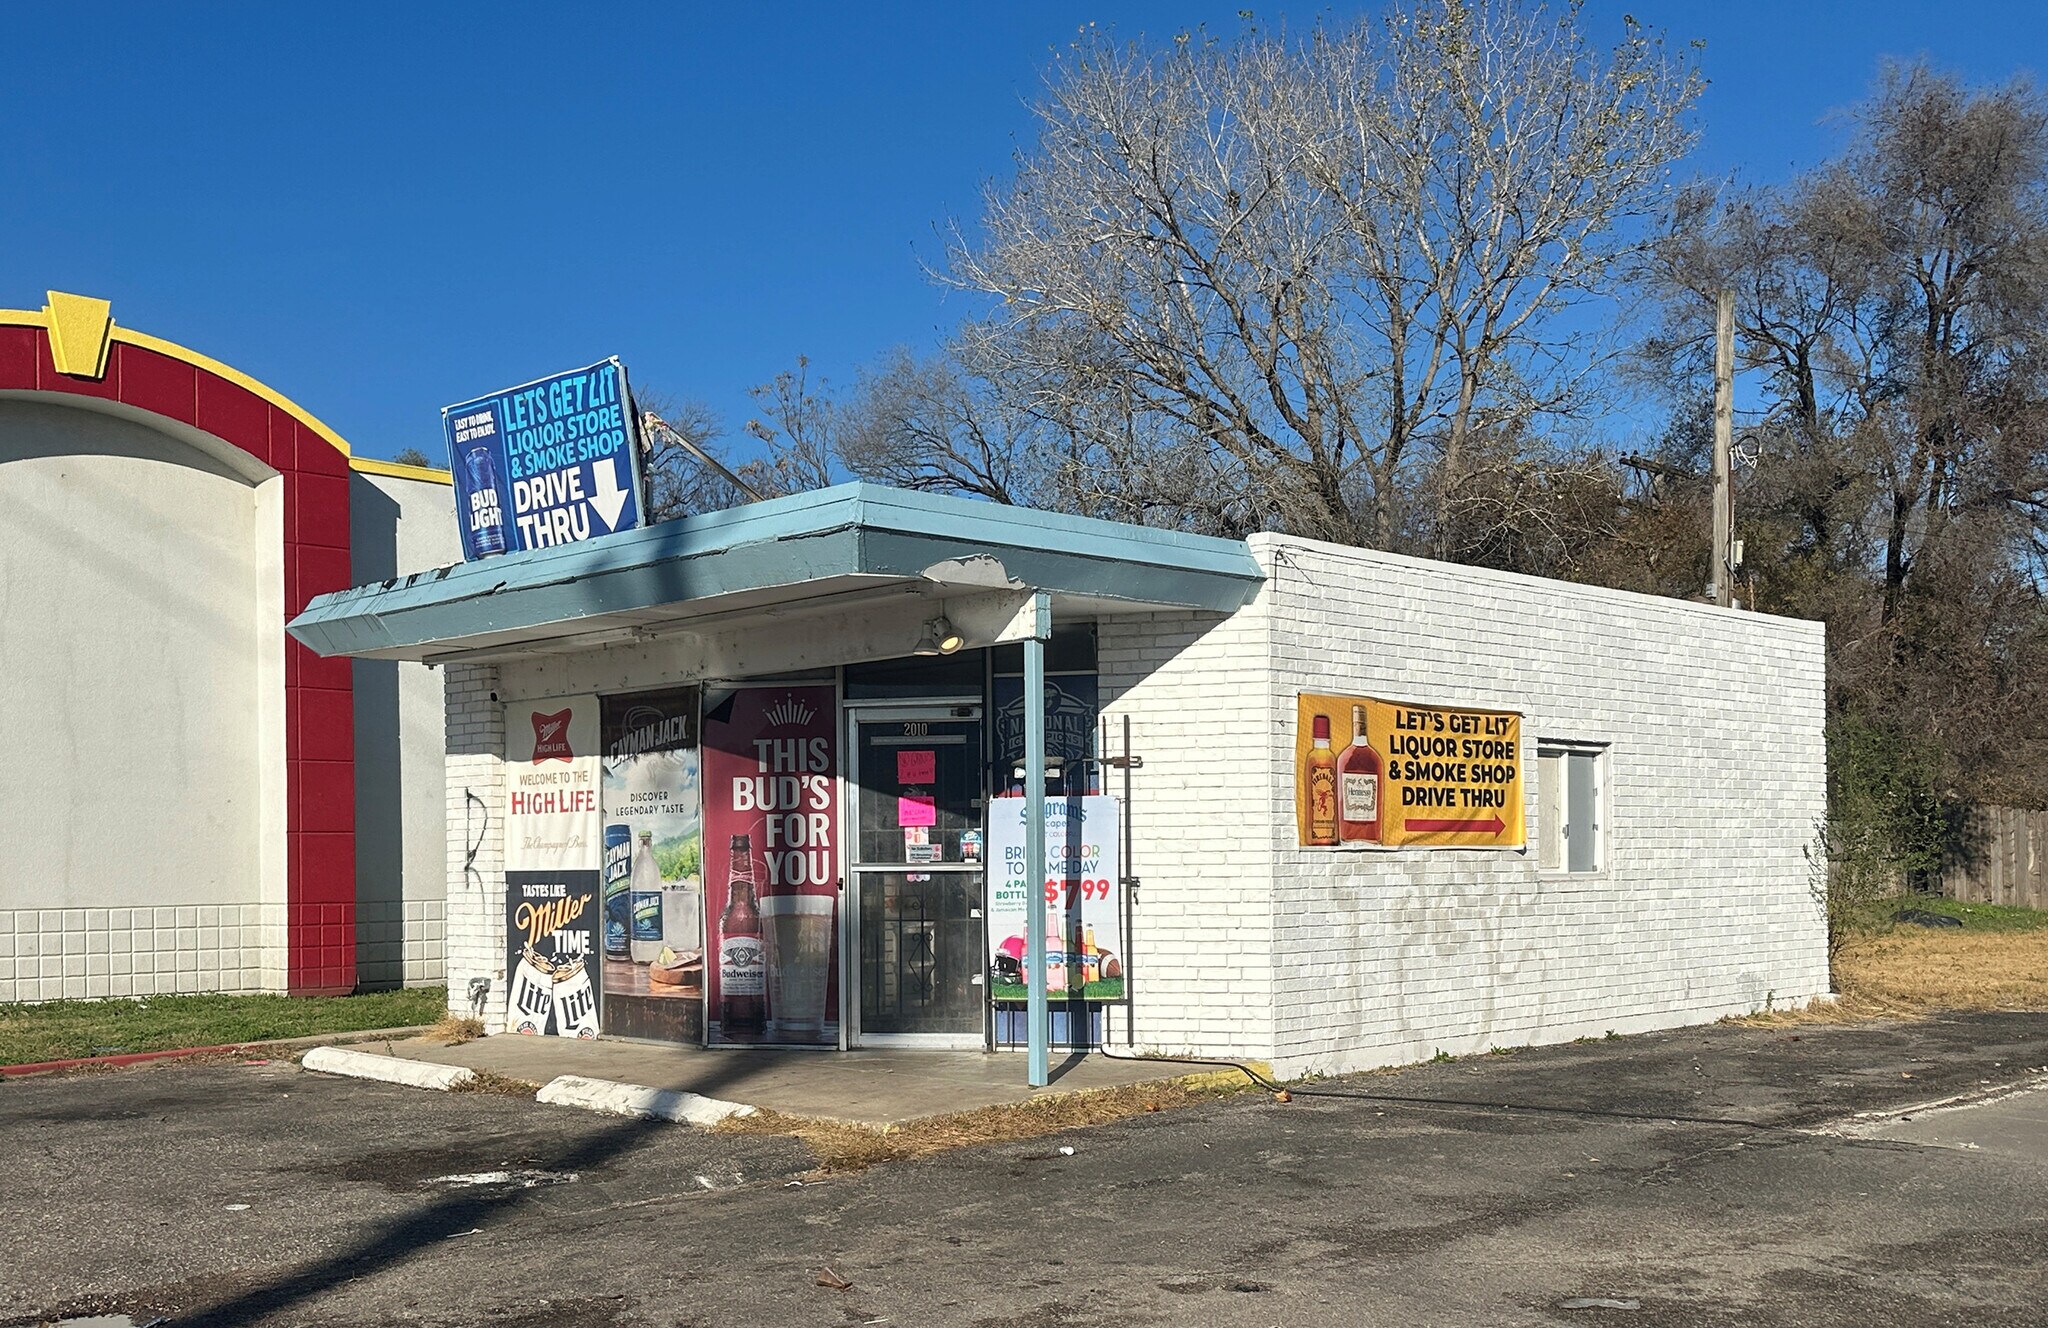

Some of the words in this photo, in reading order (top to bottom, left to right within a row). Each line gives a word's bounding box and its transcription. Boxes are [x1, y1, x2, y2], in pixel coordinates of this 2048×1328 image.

[503, 387, 548, 432] LETS
[549, 376, 587, 419] GET
[588, 365, 616, 408] LIT
[456, 429, 470, 443] EASY
[470, 427, 478, 440] TO
[507, 420, 566, 456] LIQUOR
[567, 403, 622, 440] STORE
[511, 456, 524, 479] &
[524, 441, 577, 476] SMOKE
[577, 429, 625, 461] SHOP
[470, 488, 499, 511] BUD
[513, 465, 585, 514] DRIVE
[470, 506, 504, 532] LIGHT
[516, 502, 591, 551] THRU
[903, 722, 928, 737] 2010
[1396, 710, 1445, 732] LET'S
[1449, 714, 1482, 734] GET
[1485, 716, 1510, 736] LIT
[537, 744, 552, 754] HIGH
[552, 743, 568, 752] LIFE
[610, 723, 656, 768] CAYMAN
[655, 714, 688, 746] JACK
[1389, 734, 1458, 760] LIQUOR
[1462, 739, 1515, 760] STORE
[753, 737, 830, 773] THIS
[519, 772, 558, 786] WELCOME
[559, 771, 571, 784] TO
[572, 770, 589, 783] THE
[1388, 760, 1402, 780] &
[1404, 761, 1467, 782] SMOKE
[1471, 764, 1516, 784] SHOP
[511, 791, 555, 815] HIGH
[559, 789, 596, 813] LIFE
[630, 791, 669, 802] DISCOVER
[733, 775, 831, 812] BUD'S
[1402, 786, 1456, 807] DRIVE
[1460, 788, 1506, 808] THRU
[616, 804, 660, 816] LEGENDARY
[661, 803, 685, 814] TASTE
[765, 812, 831, 849] FOR
[1050, 844, 1101, 860] COLOR
[608, 859, 628, 884] JACK
[763, 850, 831, 886] YOU
[1006, 861, 1026, 875] TO
[1072, 860, 1100, 874] DAY
[522, 884, 550, 897] TASTES
[549, 884, 567, 897] LIKE
[1005, 880, 1012, 888] 4
[1014, 880, 1028, 888] PA
[514, 893, 593, 948] Miller
[721, 968, 765, 979] Budweiser
[516, 974, 551, 1017] Lite
[560, 985, 593, 1031] Lite
